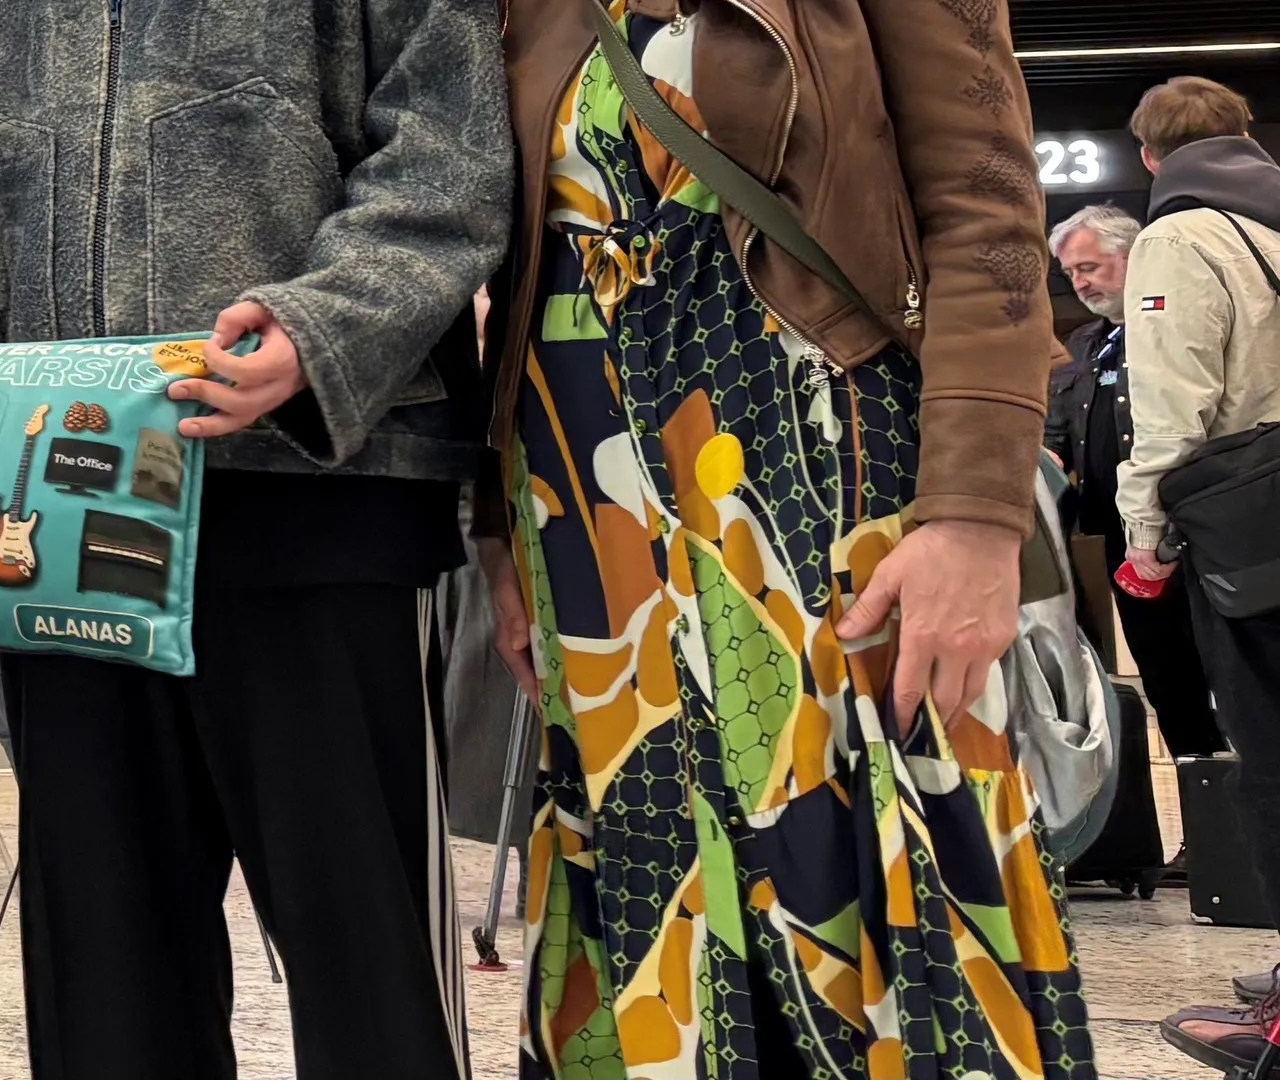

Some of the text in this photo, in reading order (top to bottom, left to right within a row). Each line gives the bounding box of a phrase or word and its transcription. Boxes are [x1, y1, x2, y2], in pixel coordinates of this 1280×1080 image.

[1035, 139, 1101, 184] 23
[54, 453, 114, 472] The Office
[34, 615, 133, 646] ALANAS
